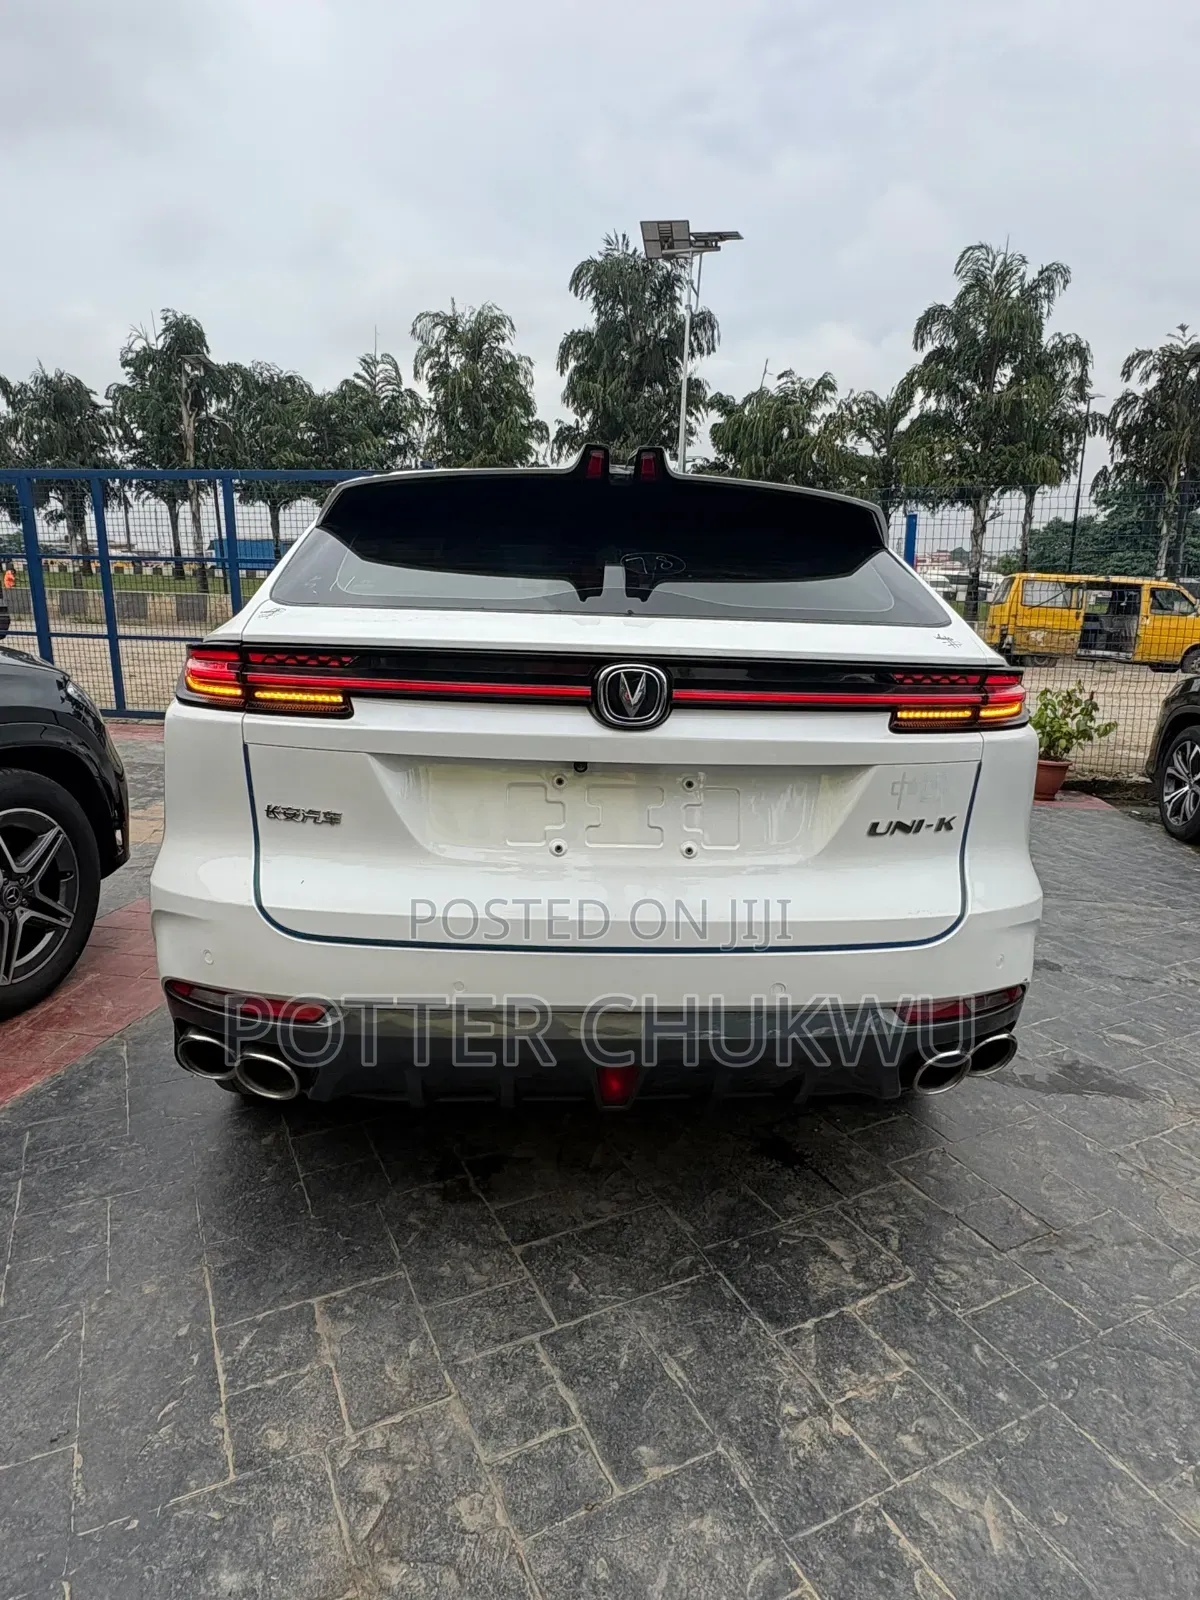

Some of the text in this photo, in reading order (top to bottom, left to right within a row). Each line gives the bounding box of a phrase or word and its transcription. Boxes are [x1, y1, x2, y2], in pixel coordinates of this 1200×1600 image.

[264, 804, 343, 826] 长安汽车
[867, 815, 957, 837] UNI-K
